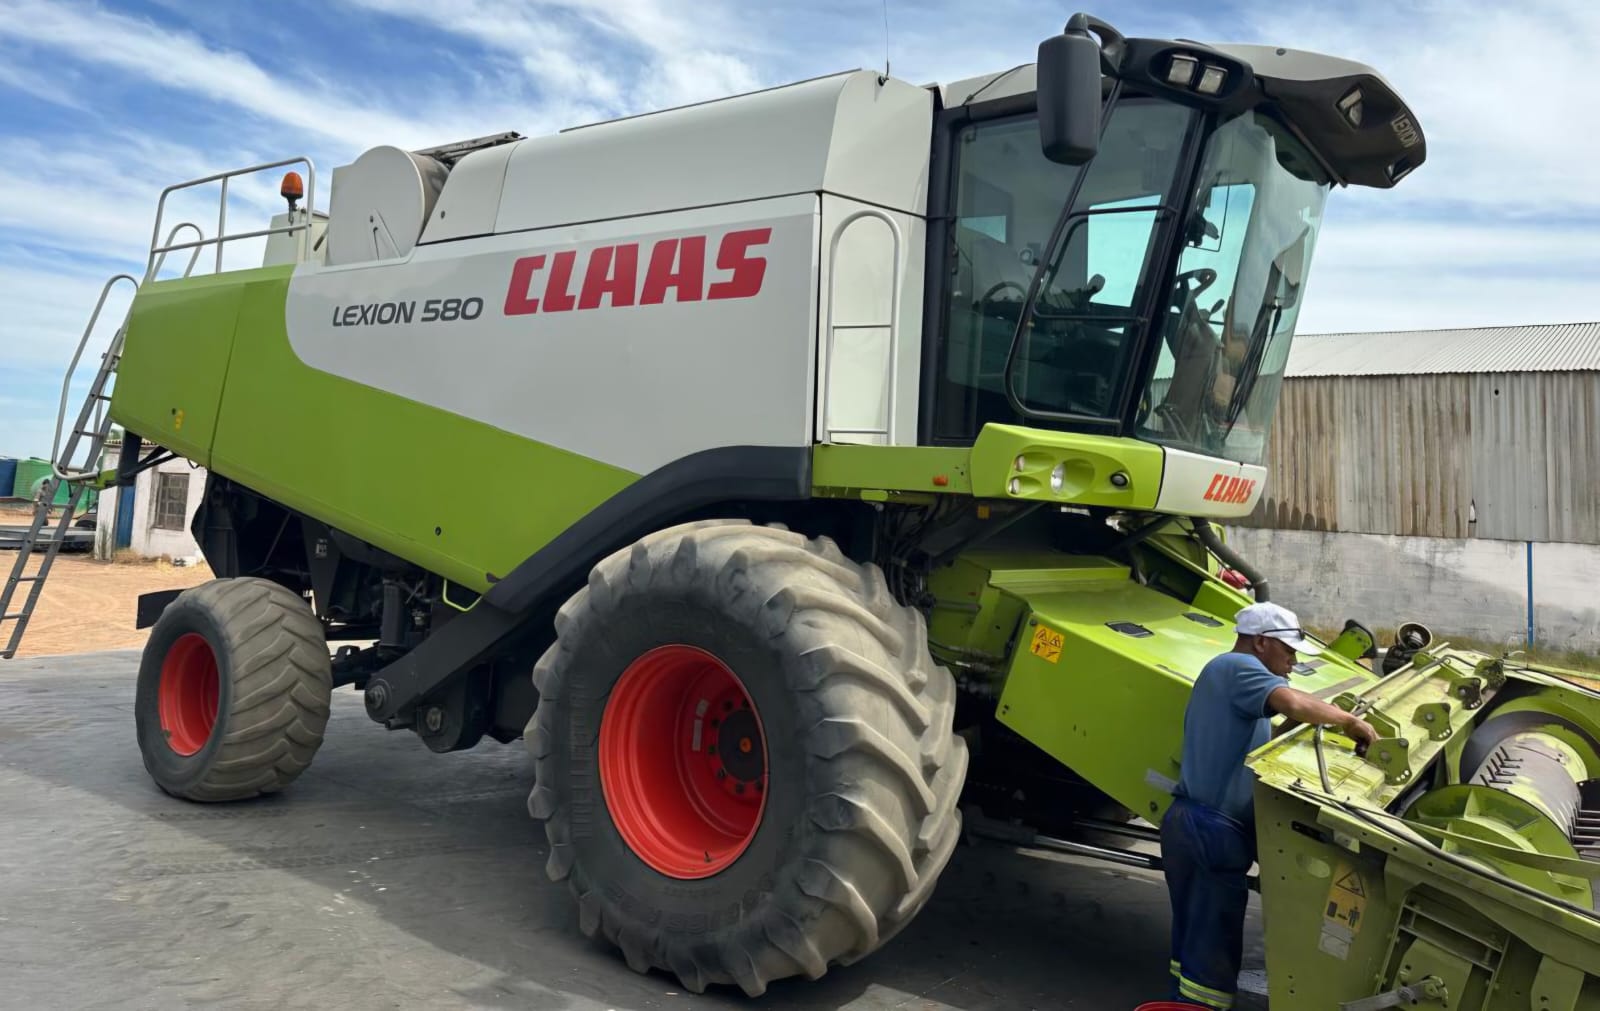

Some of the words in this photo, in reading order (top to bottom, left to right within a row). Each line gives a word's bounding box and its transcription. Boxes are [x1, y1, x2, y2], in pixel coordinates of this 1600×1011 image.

[503, 227, 773, 316] CLAAS
[332, 301, 417, 327] LEXION
[420, 297, 484, 322] 580
[1203, 473, 1257, 504] CLAAS
